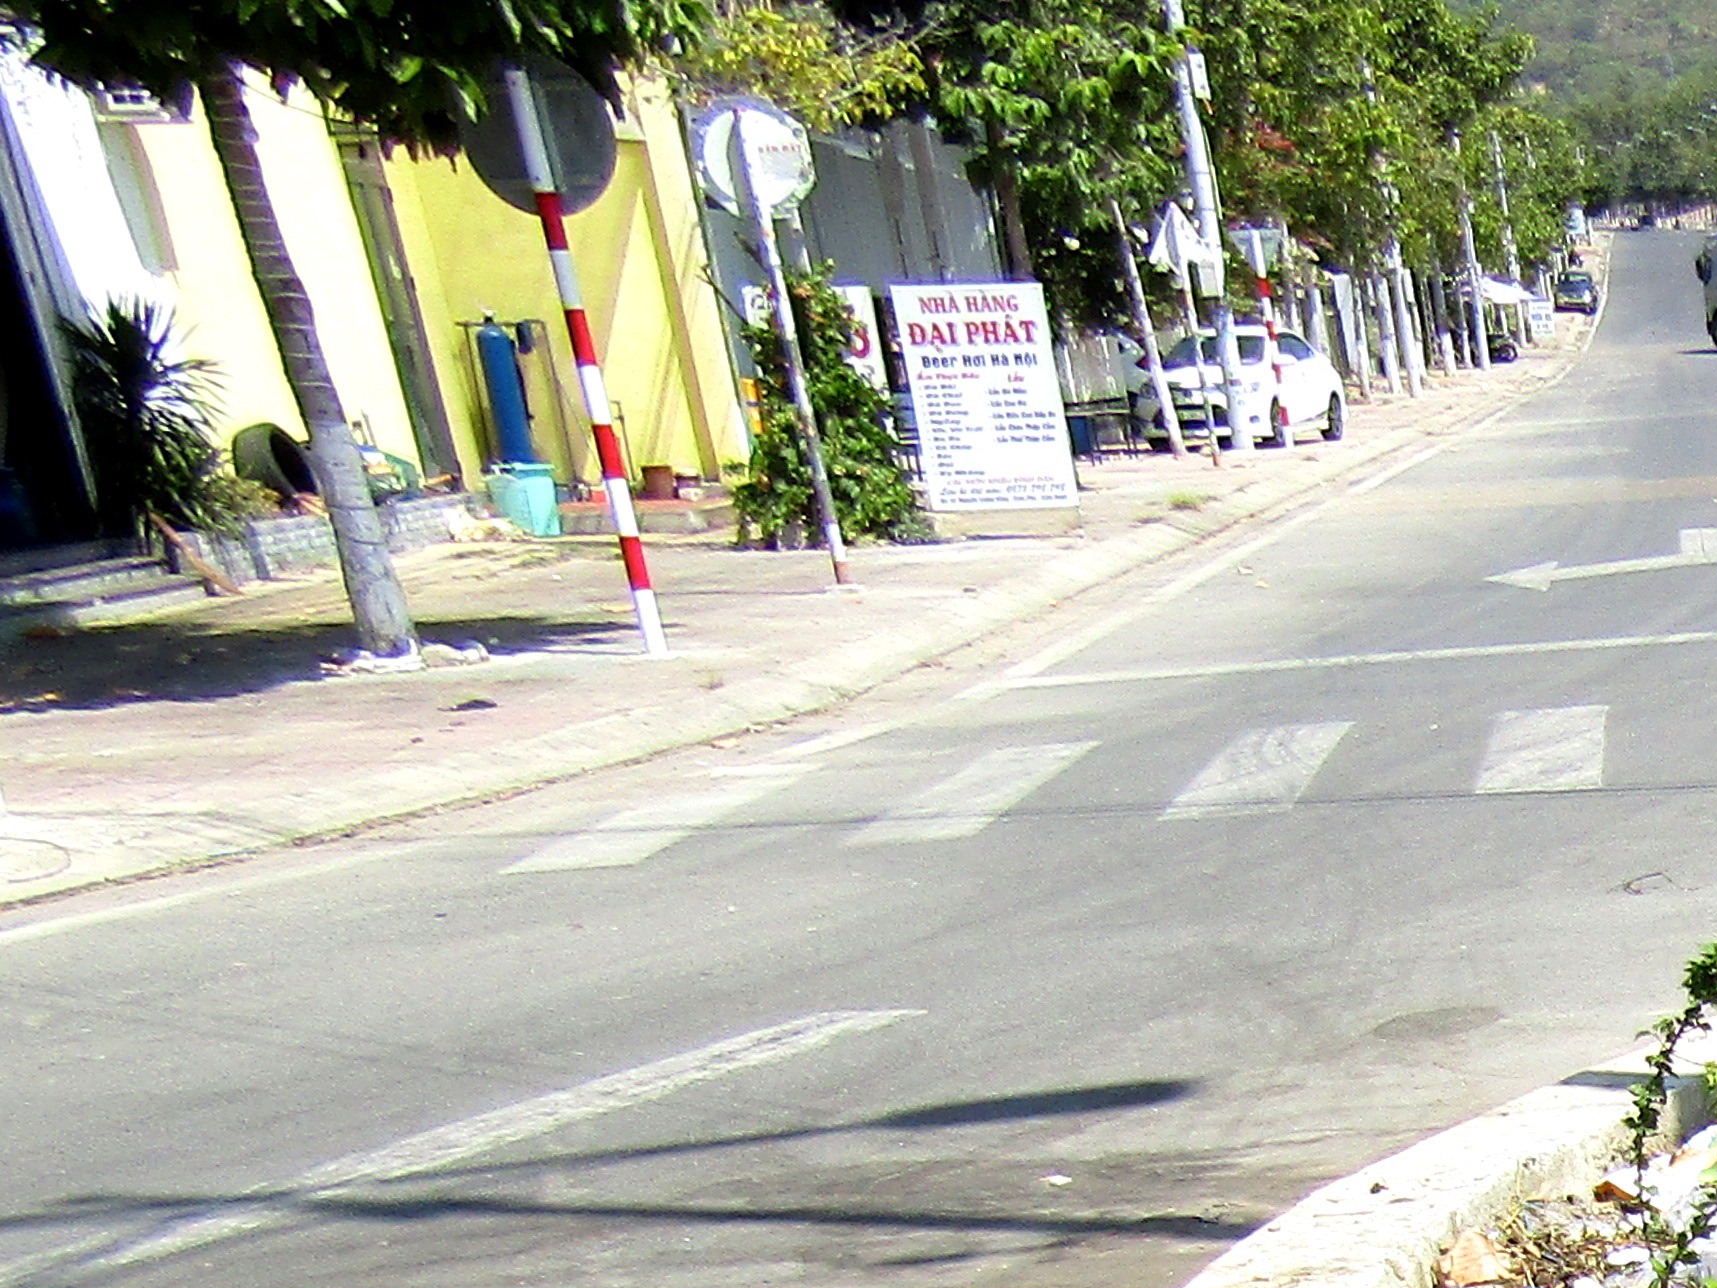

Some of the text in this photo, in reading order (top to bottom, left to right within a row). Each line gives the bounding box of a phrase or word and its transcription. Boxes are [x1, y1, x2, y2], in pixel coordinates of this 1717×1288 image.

[918, 289, 1019, 314] NHÀ HÀNG
[907, 321, 959, 353] ĐẠI
